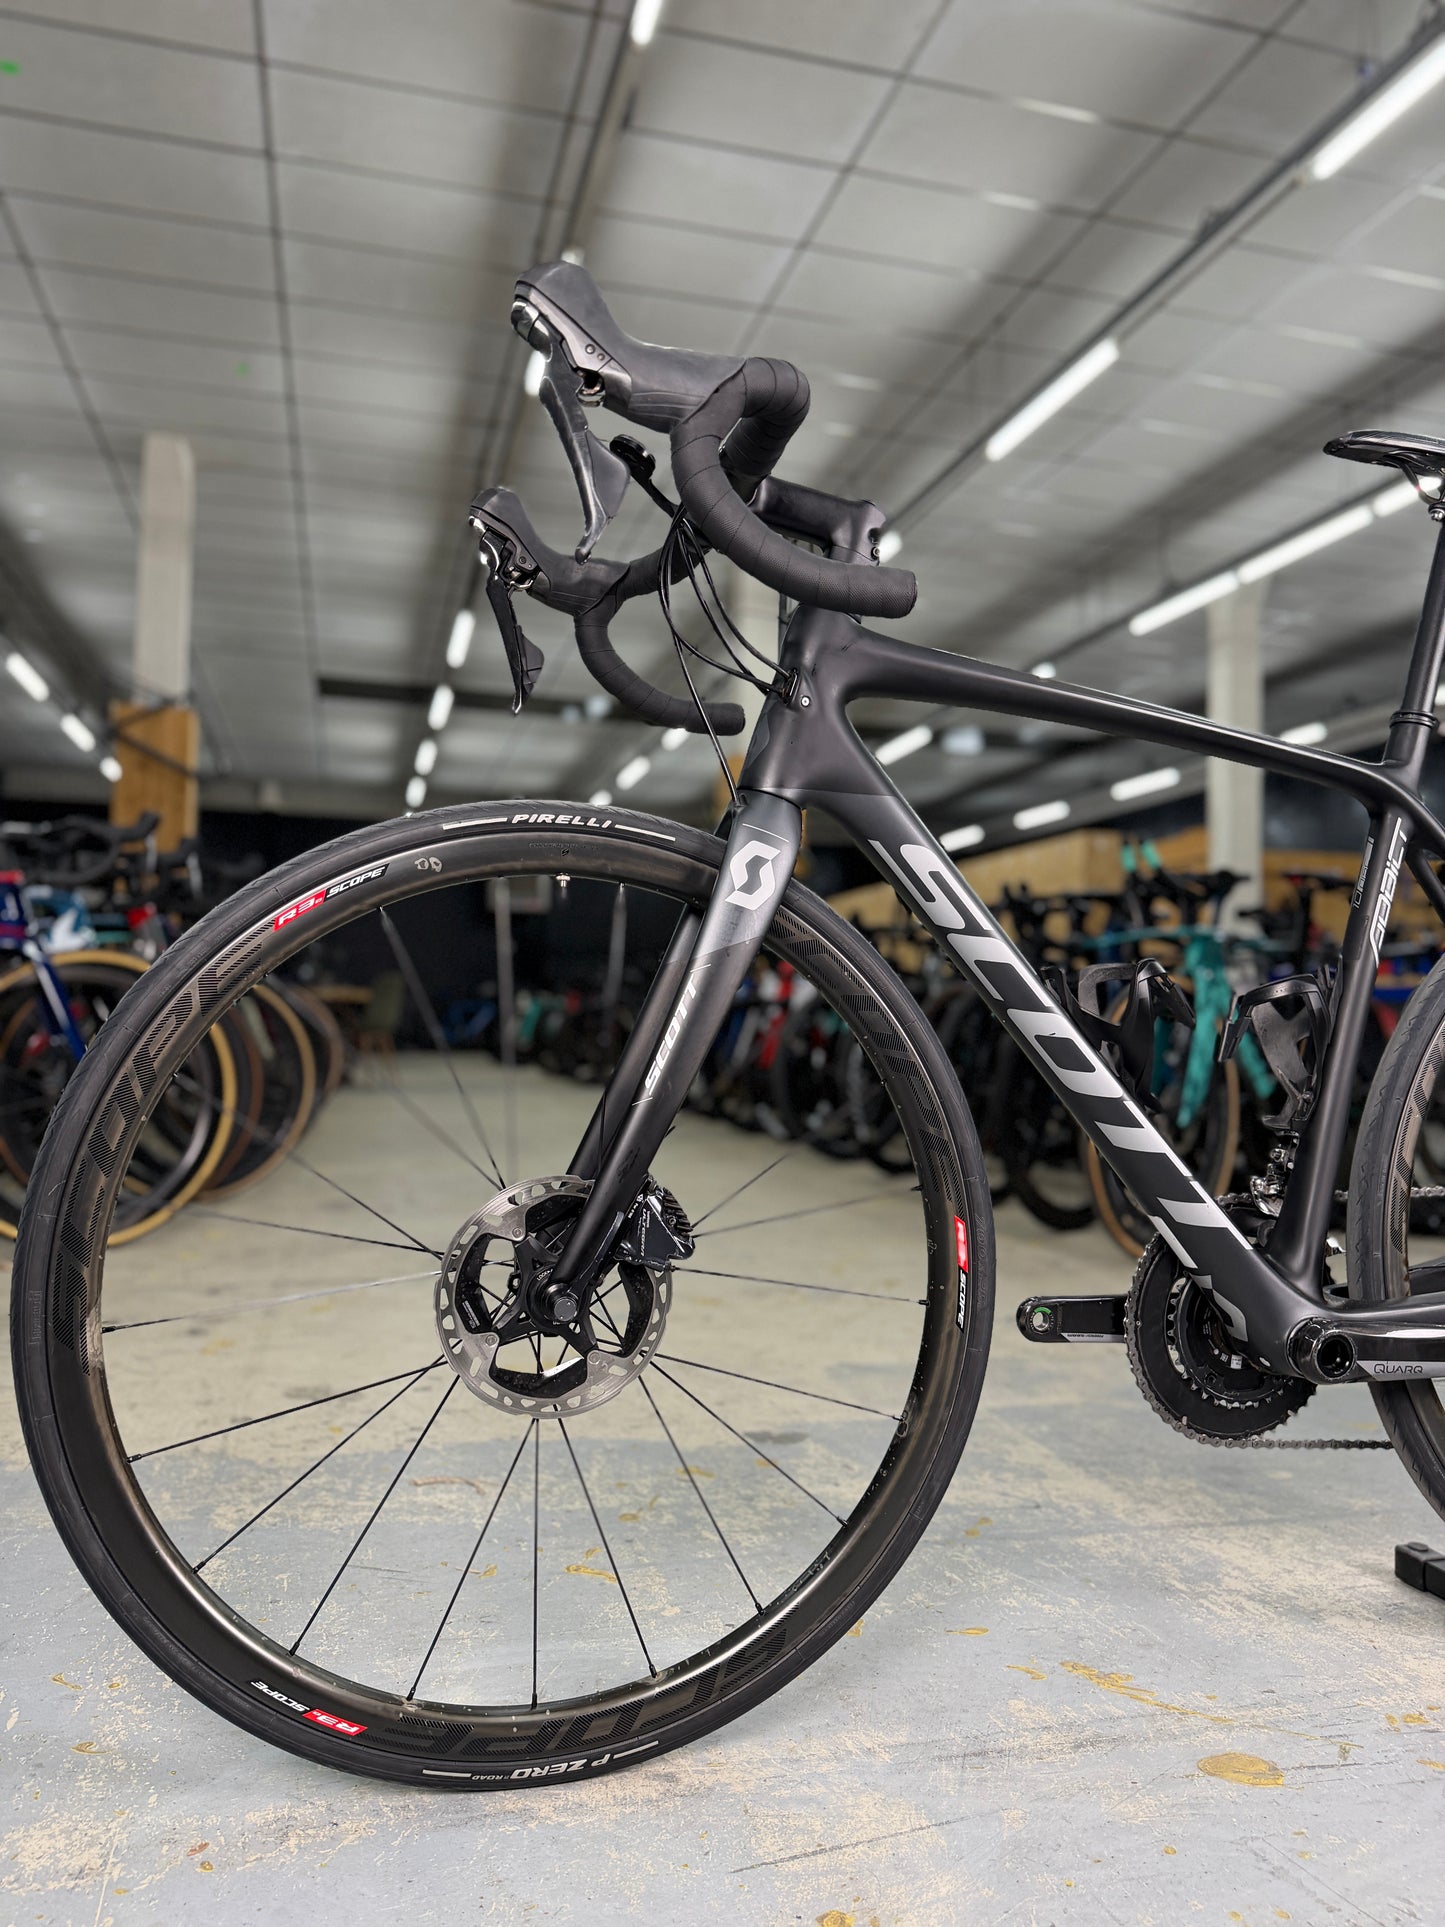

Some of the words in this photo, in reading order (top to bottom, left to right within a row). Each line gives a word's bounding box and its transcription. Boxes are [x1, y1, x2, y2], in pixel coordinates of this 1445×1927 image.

[511, 813, 612, 828] PIRELLI
[326, 866, 386, 898] SCOPE
[644, 973, 697, 1096] SCOTT
[869, 839, 1254, 1251] SCOTT
[52, 919, 276, 1376] SCOPE
[958, 1269, 967, 1329] SCOPE
[1373, 1362, 1424, 1374] QUARQ
[364, 1600, 800, 1757] SCOPE
[250, 1681, 311, 1712] SCOPE
[510, 1758, 588, 1780] ZERO
[591, 1753, 612, 1768] P
